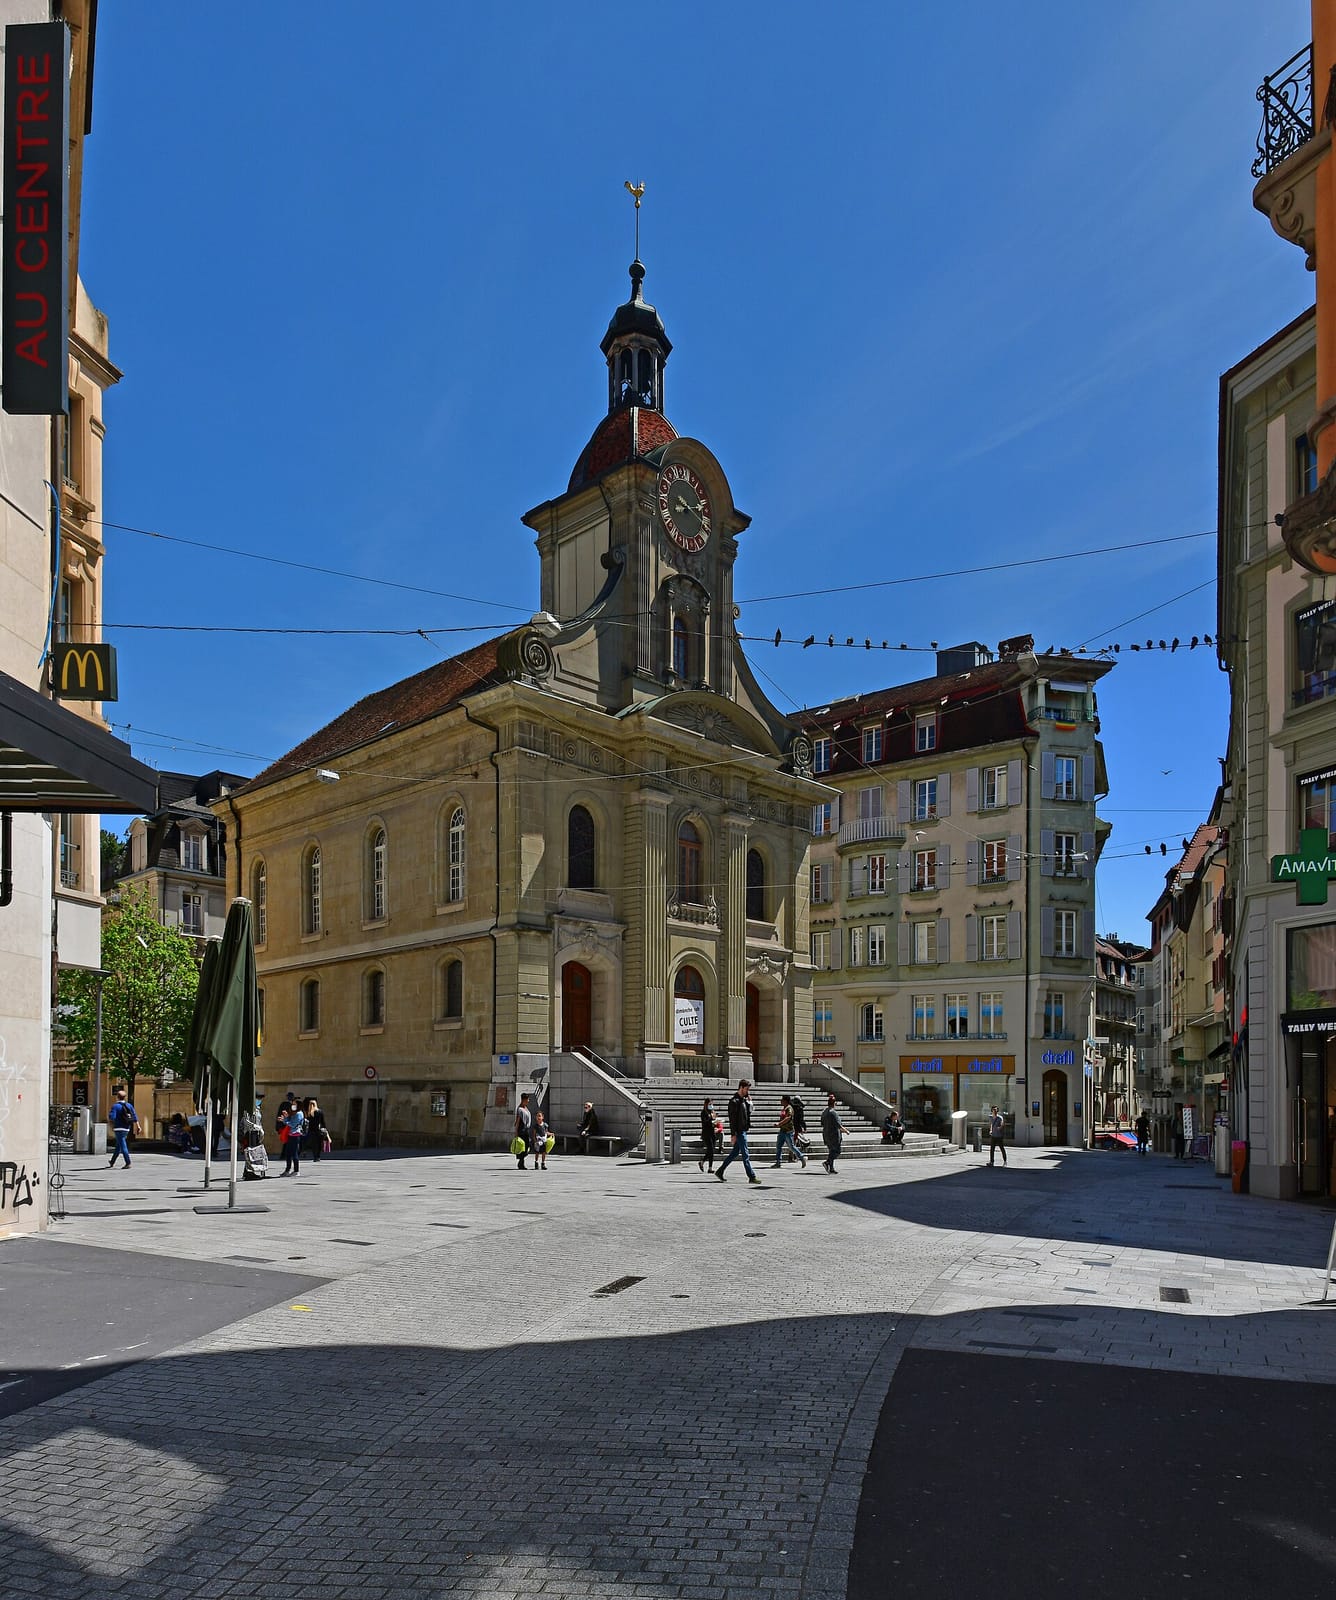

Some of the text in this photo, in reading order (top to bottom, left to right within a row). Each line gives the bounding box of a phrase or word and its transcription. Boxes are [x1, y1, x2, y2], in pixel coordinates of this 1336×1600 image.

[15, 51, 51, 368] AU CENTRE
[1299, 608, 1317, 620] TALLY
[62, 649, 104, 691] M
[1300, 775, 1319, 785] TALLY
[679, 1016, 699, 1026] CULTE
[1287, 1024, 1315, 1033] TALLY
